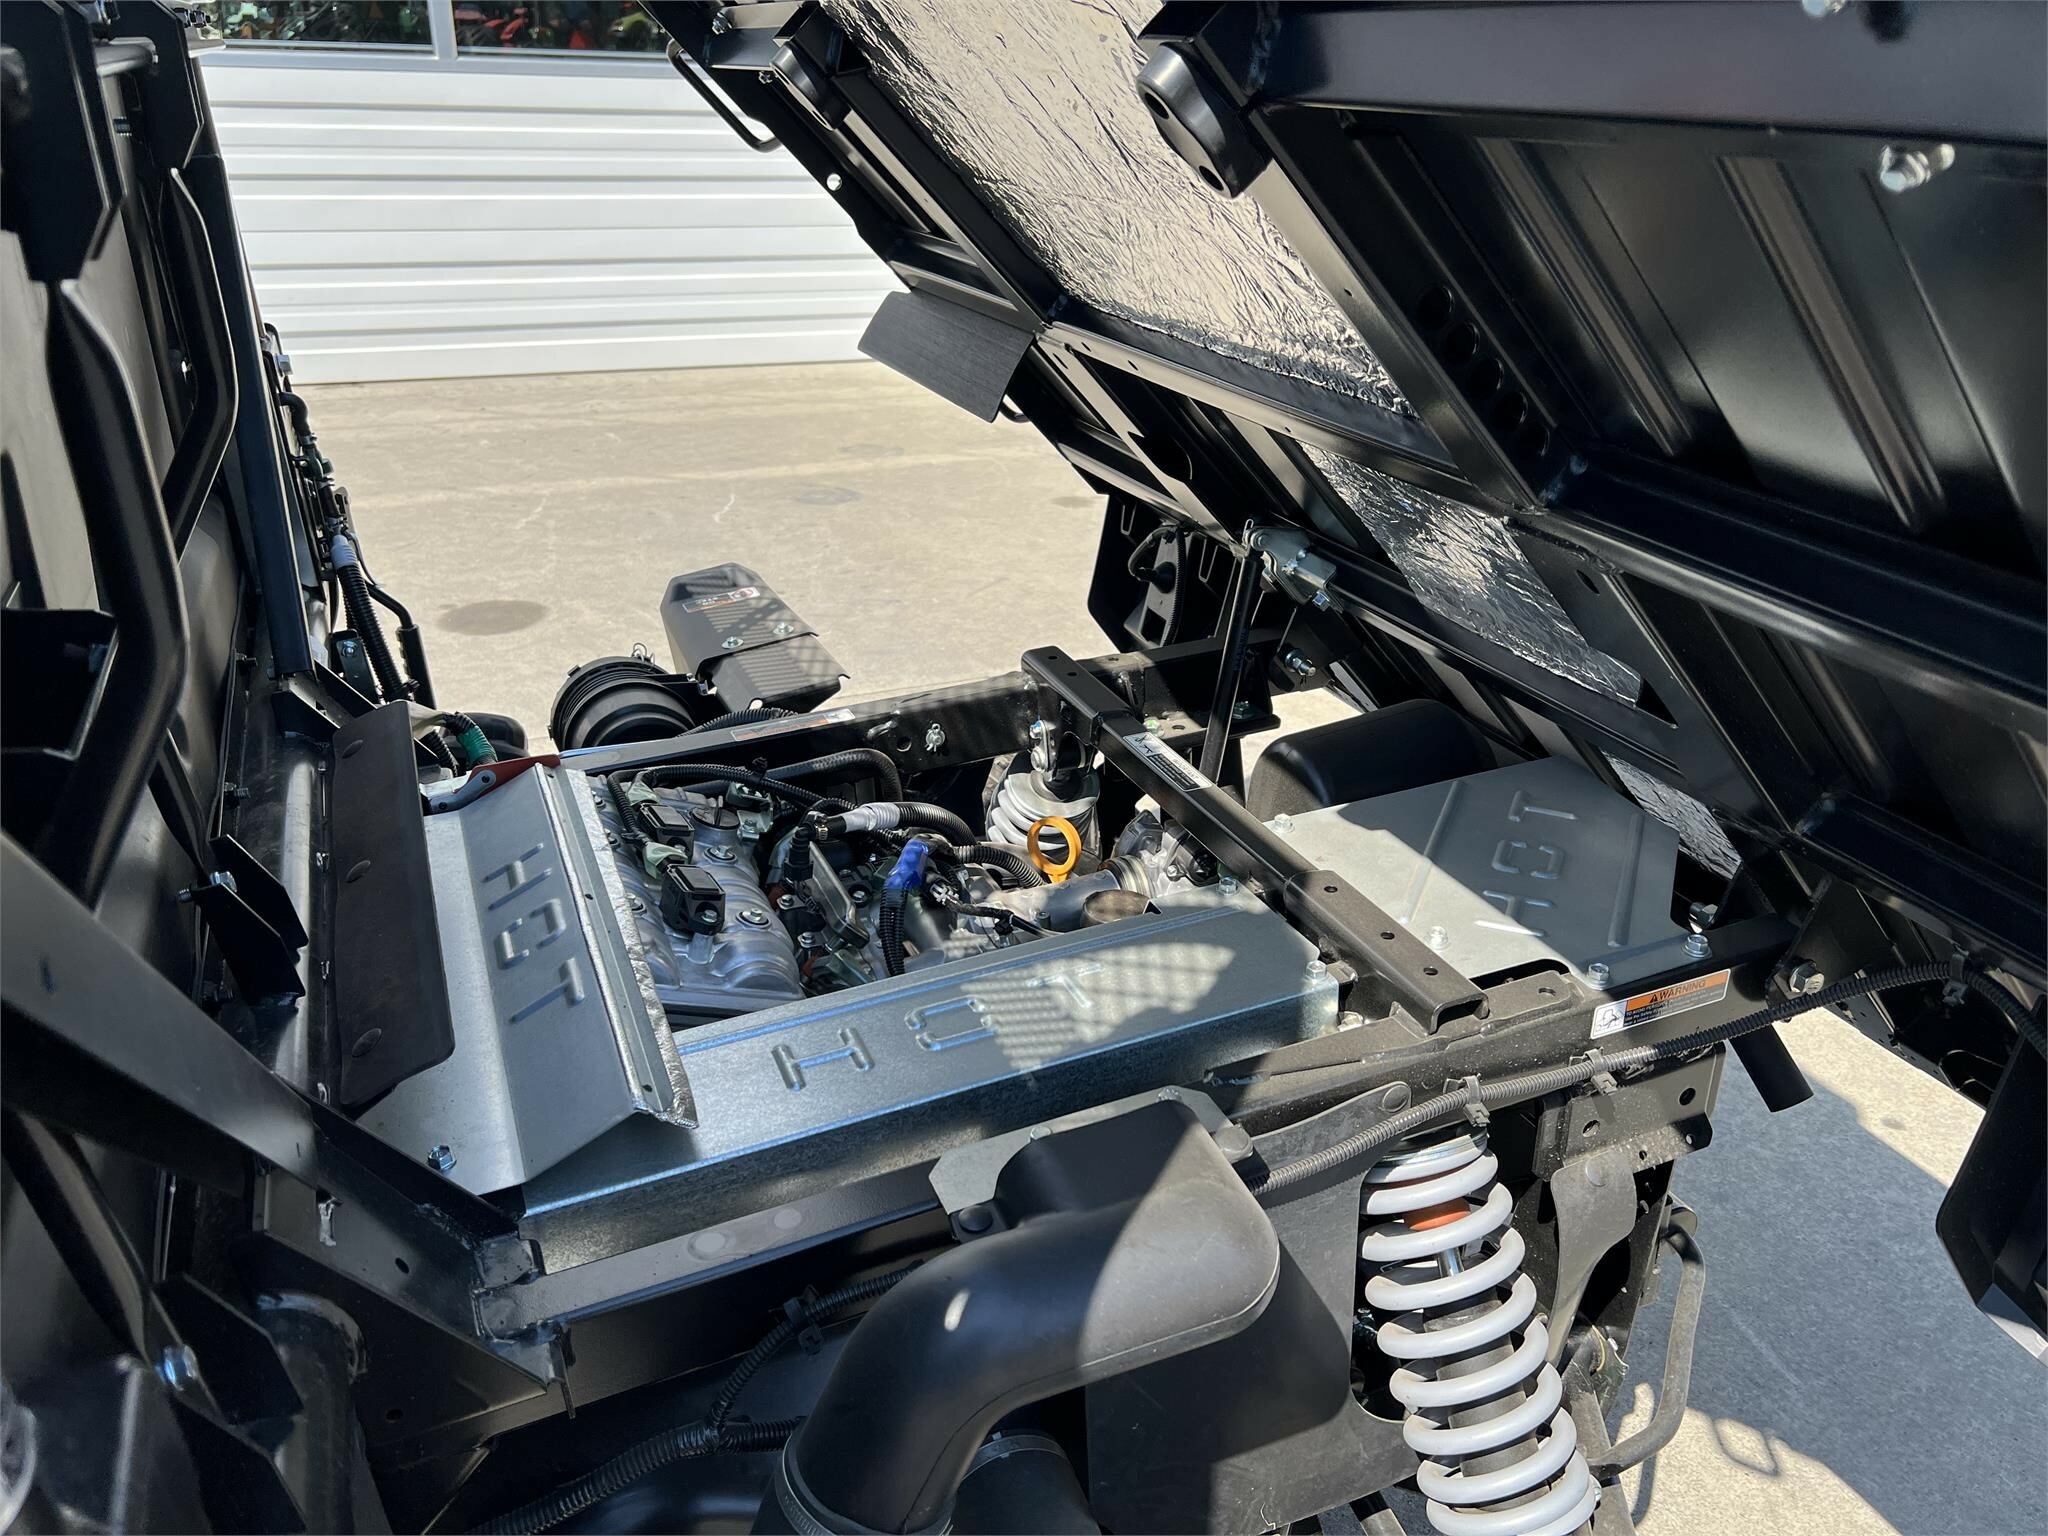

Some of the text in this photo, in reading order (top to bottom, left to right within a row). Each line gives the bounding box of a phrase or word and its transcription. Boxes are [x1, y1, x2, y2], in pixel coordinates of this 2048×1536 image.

[1474, 790, 1579, 938] HOT
[481, 842, 586, 1025] HOT
[1659, 979, 1706, 999] WARNING
[770, 964, 1104, 1092] HOT
